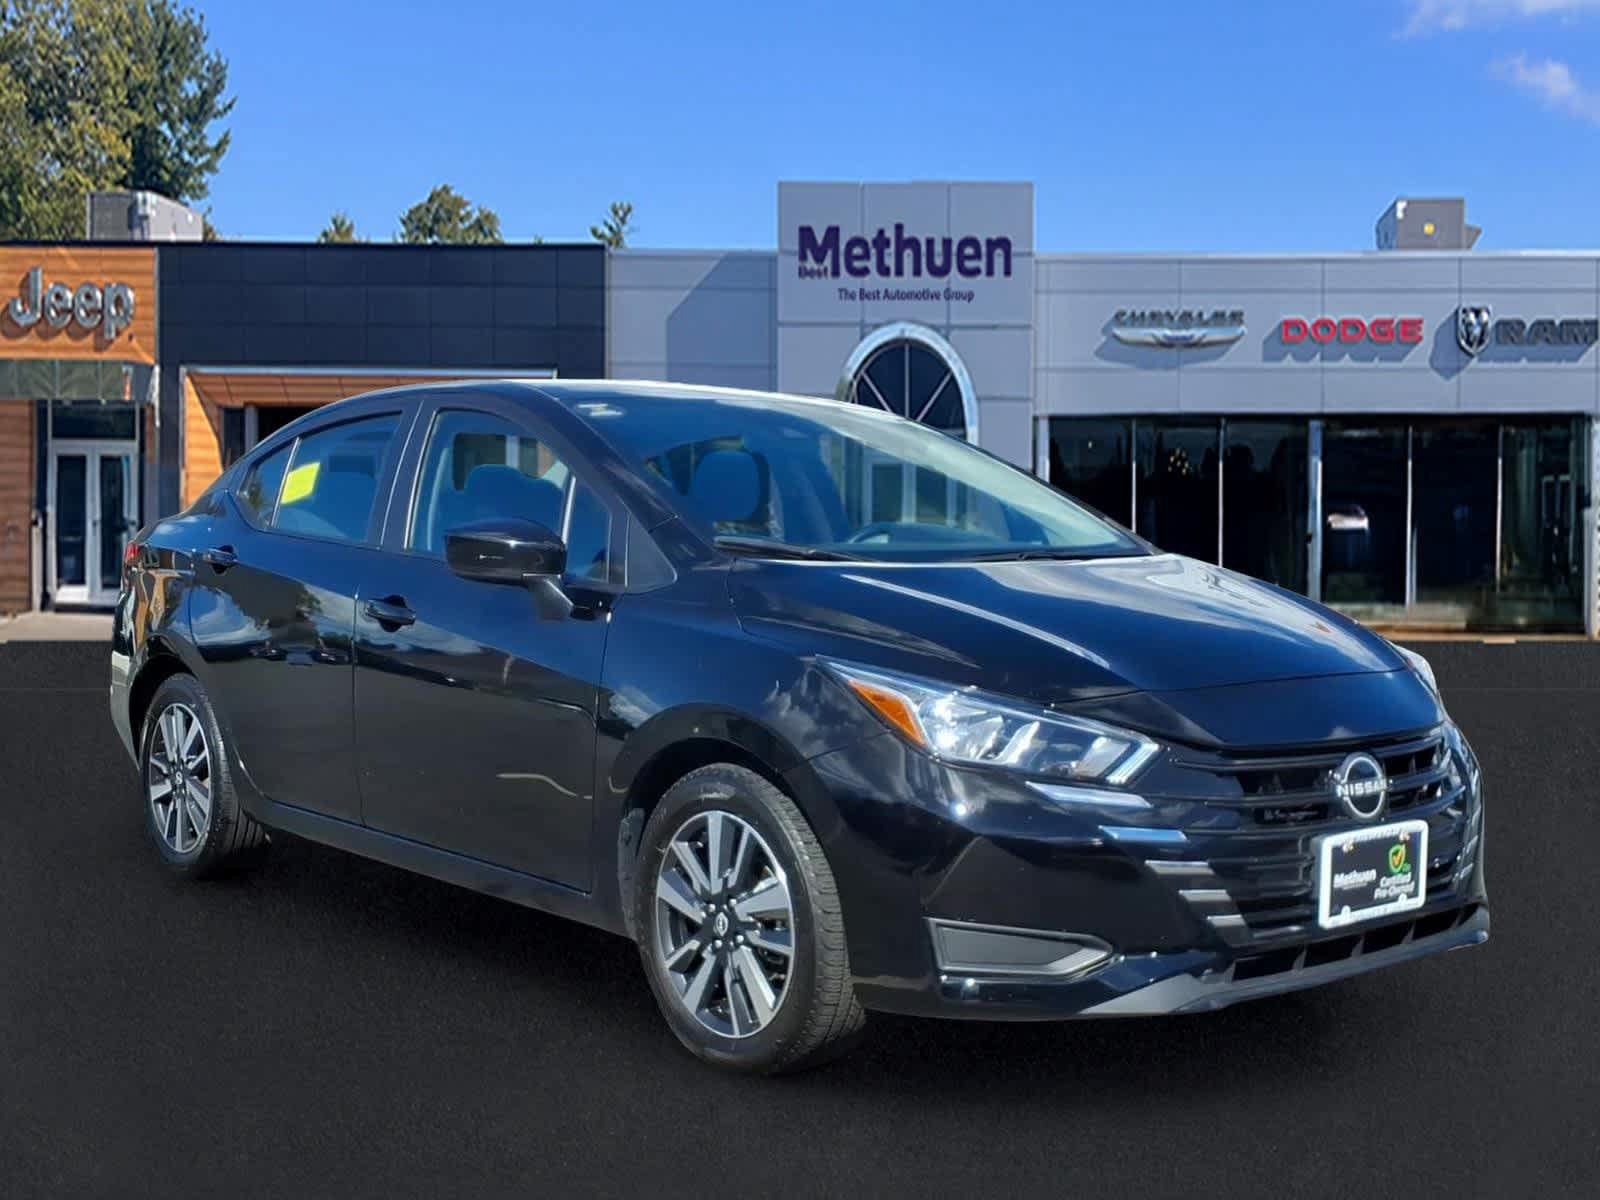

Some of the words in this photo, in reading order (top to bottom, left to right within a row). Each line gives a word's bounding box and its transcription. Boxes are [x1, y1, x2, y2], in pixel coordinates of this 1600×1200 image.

[798, 222, 1012, 278] Methuen
[798, 266, 828, 279] Best
[8, 266, 135, 340] Jeep
[838, 288, 856, 301] The
[859, 288, 880, 301] Best
[883, 287, 941, 301] Automotive
[943, 287, 975, 303] Group
[1114, 310, 1244, 328] CHRYSLER
[1281, 318, 1422, 343] DODGE
[1495, 319, 1599, 345] RAM
[1336, 780, 1387, 798] NISSAN
